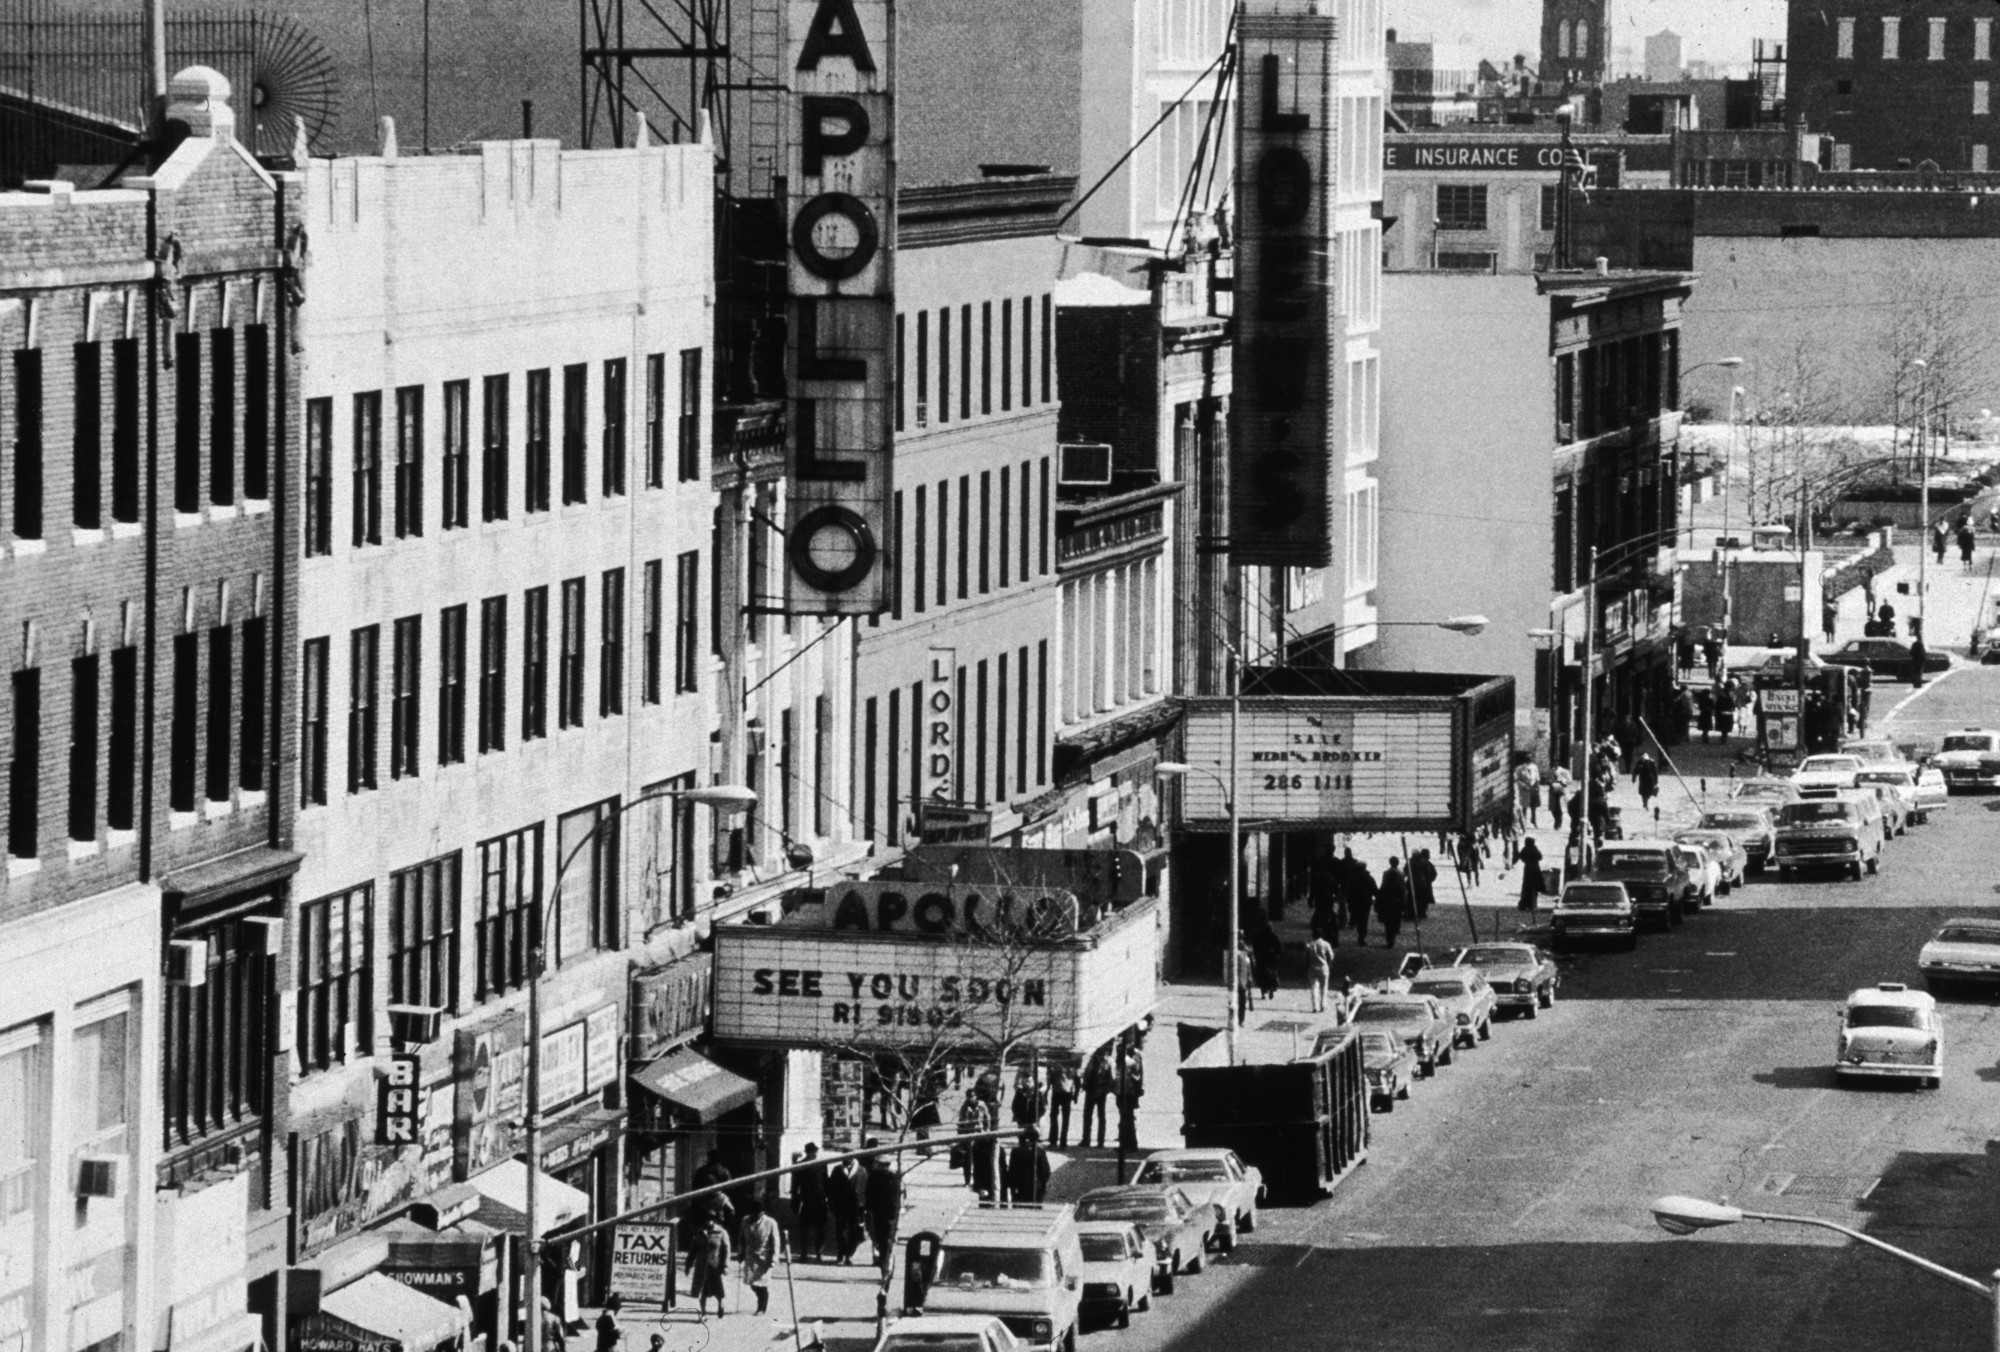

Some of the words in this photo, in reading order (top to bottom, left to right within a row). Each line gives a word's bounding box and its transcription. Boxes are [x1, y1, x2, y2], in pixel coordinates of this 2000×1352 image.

[1383, 148, 1397, 166] E
[1415, 147, 1519, 167] INSURANCE
[788, 0, 877, 592] APOLLO
[1293, 734, 1342, 745] SALE
[1263, 774, 1302, 790] 286
[754, 968, 822, 997] SEE
[847, 971, 920, 1001] YOU
[939, 975, 1045, 1006] SOON
[387, 1060, 413, 1141] BAR
[618, 1233, 666, 1252] TAX
[613, 1251, 668, 1266] RETURNS
[300, 1338, 354, 1351] HOWARD
